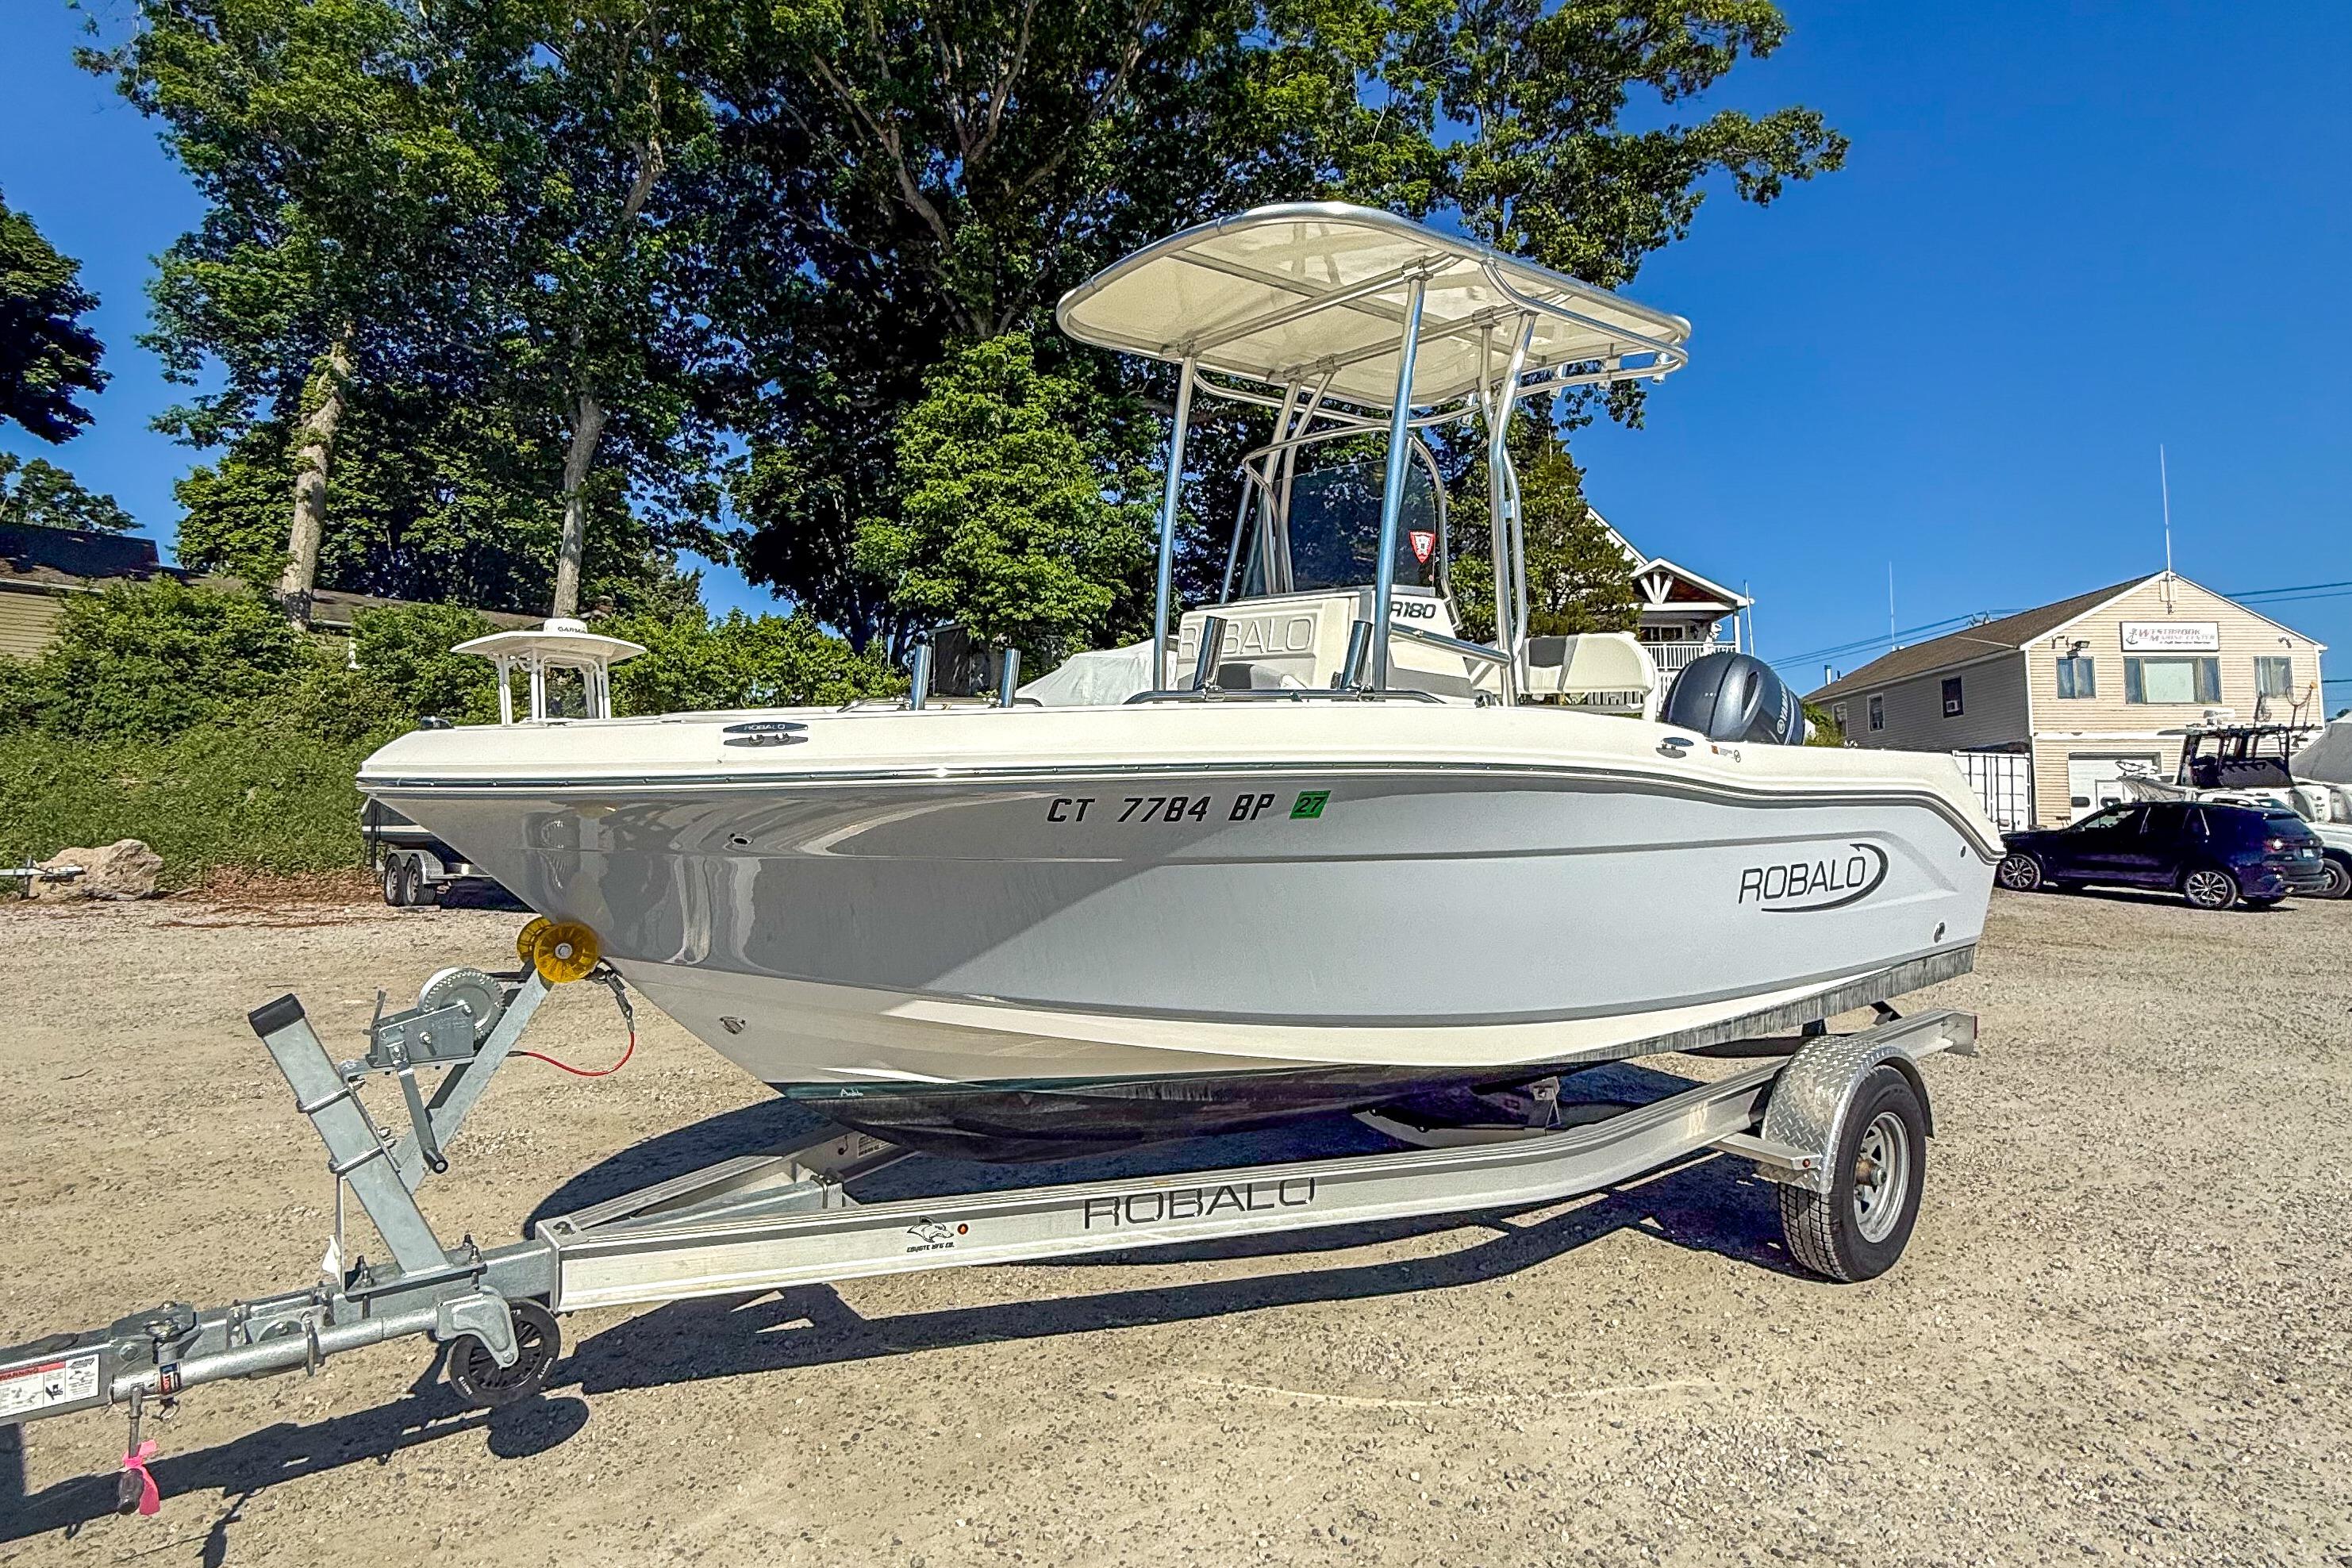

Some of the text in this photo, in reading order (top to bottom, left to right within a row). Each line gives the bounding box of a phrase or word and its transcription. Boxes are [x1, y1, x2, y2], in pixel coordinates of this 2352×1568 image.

[1390, 601, 1436, 619] R180
[1178, 616, 1314, 658] RBALO
[1047, 794, 1275, 822] CT 7784 BP
[1295, 797, 1327, 813] 27
[1739, 856, 1866, 904] ROBALO
[1084, 1178, 1315, 1229] ROBALO
